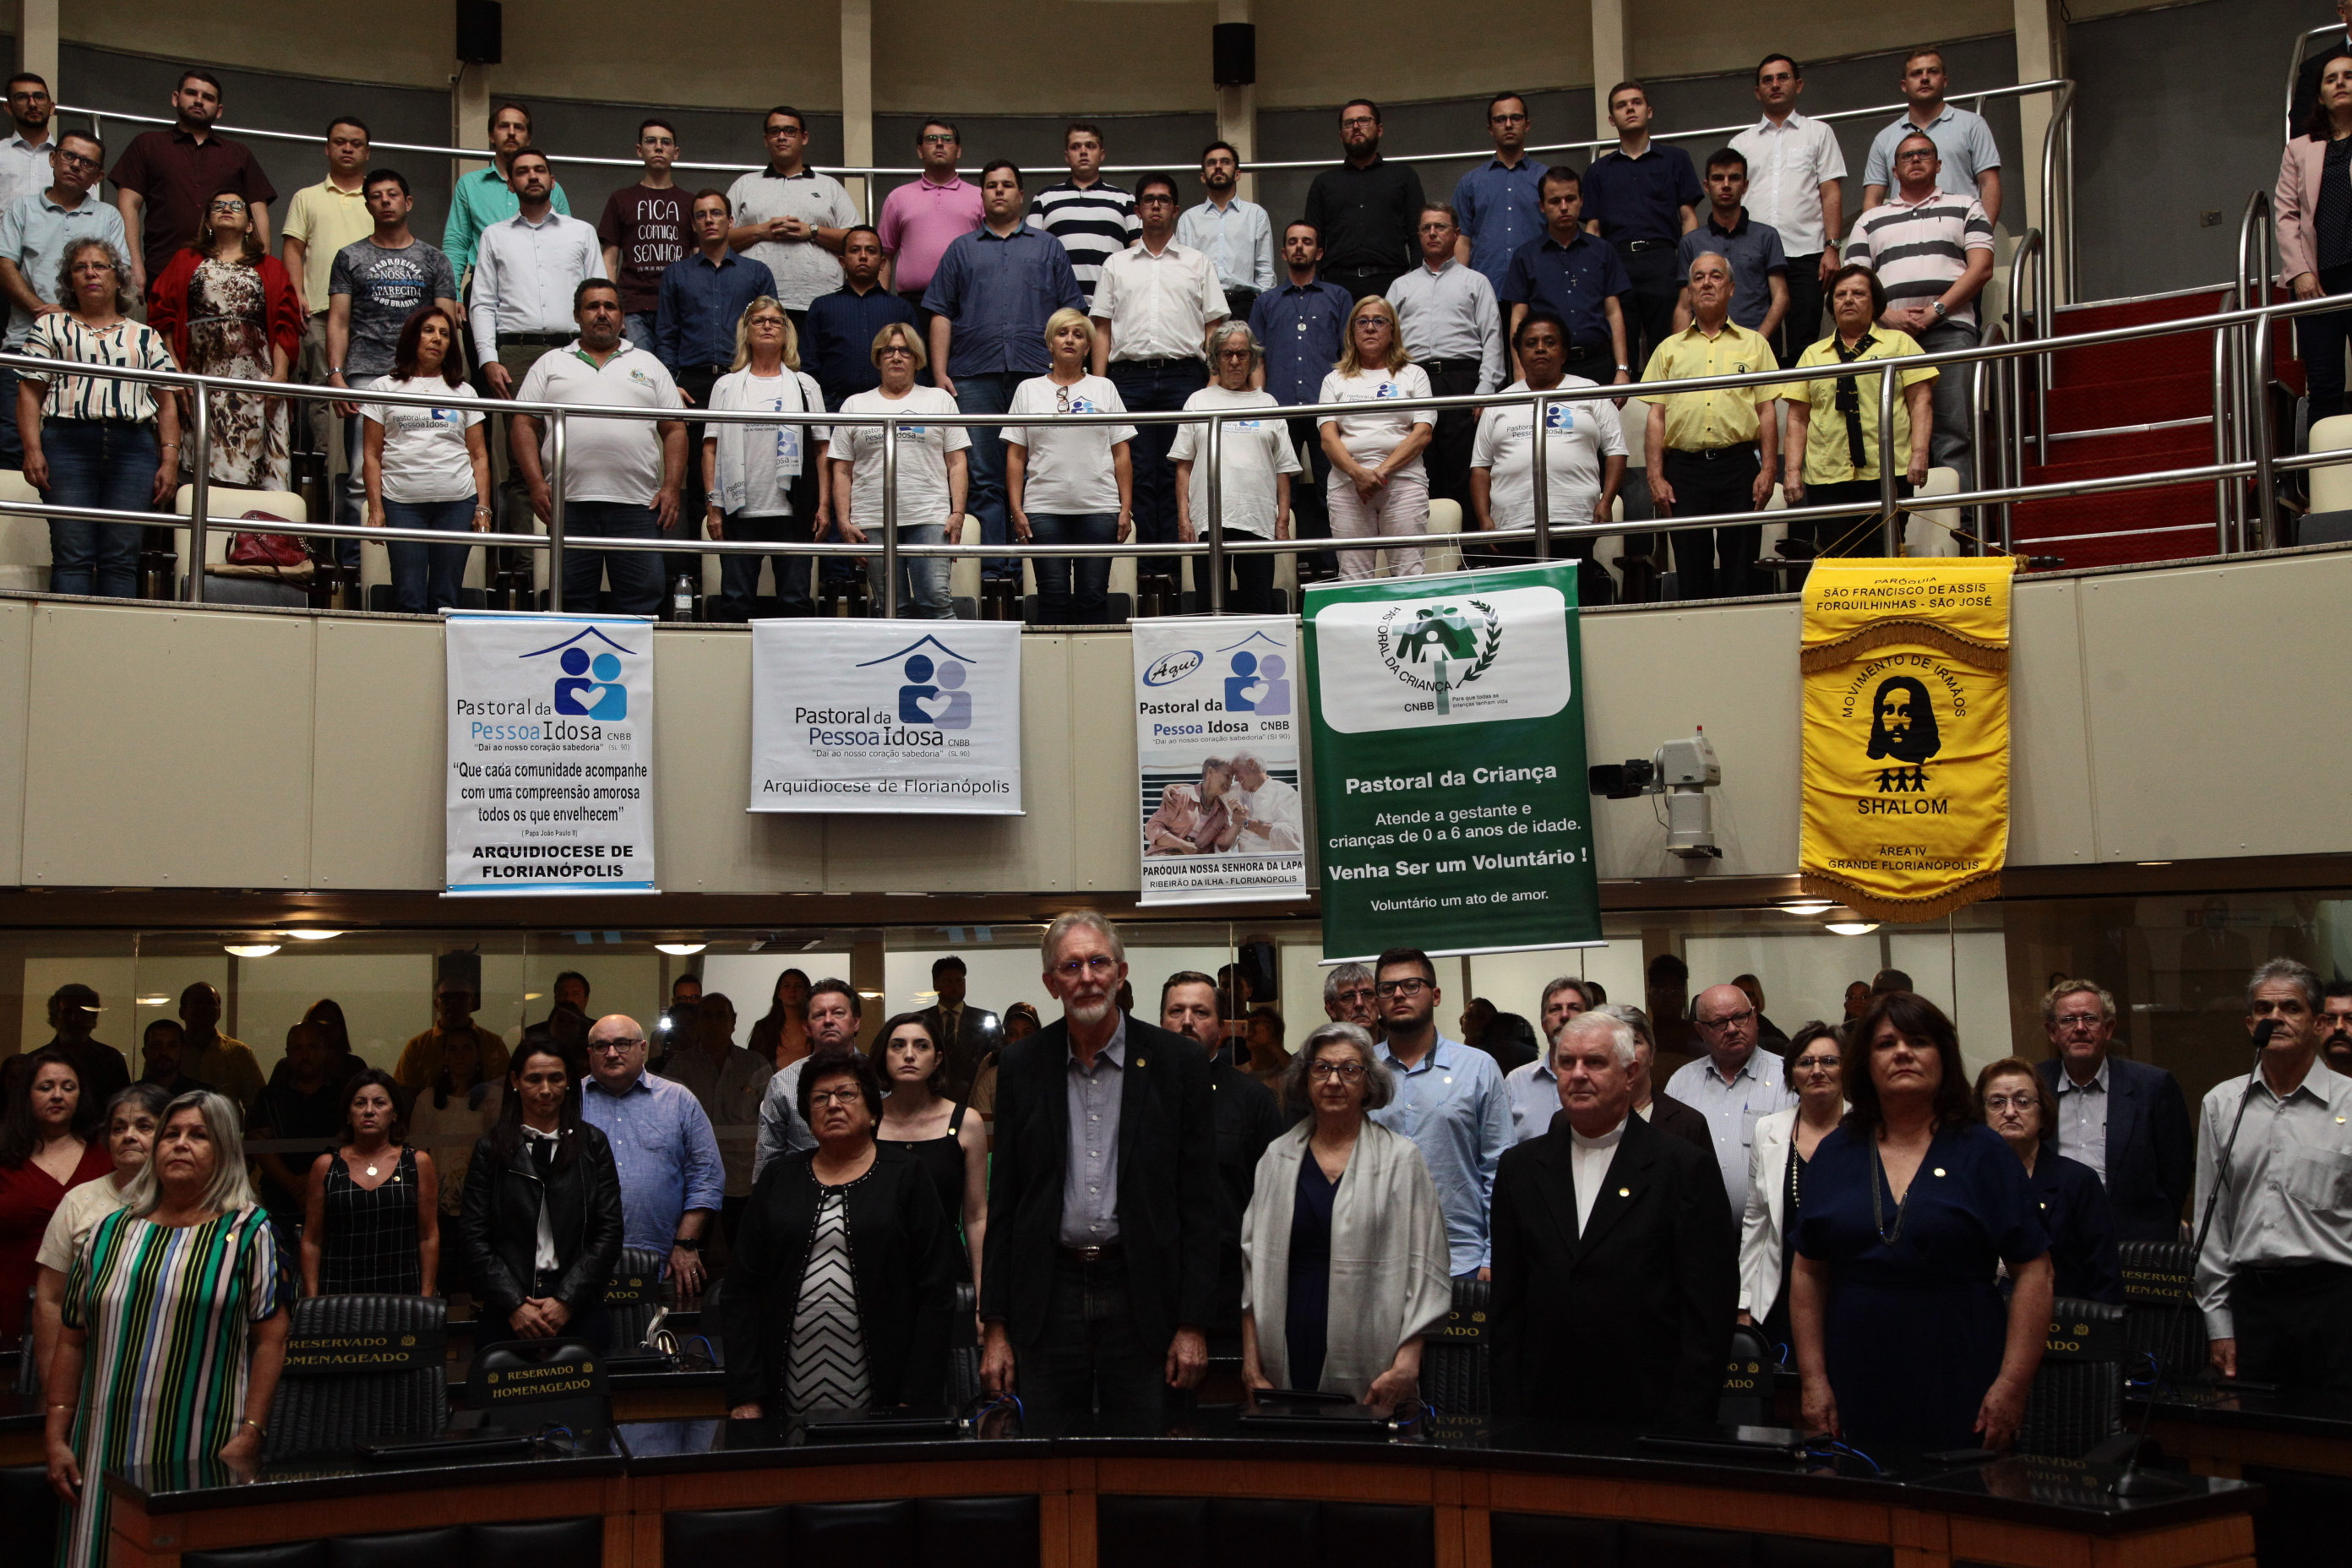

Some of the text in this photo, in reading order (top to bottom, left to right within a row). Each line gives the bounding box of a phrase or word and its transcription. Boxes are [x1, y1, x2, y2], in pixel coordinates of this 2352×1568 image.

[638, 199, 678, 221] FICA
[639, 225, 678, 241] COMIGO
[634, 243, 683, 263] SENHOR
[369, 259, 421, 275] PADROEIRA
[380, 270, 411, 280] NOSSA
[372, 286, 421, 297] APARECIDA
[391, 299, 415, 308] BRASIL
[727, 482, 744, 493] Pastor
[1824, 589, 1848, 597] SÃO
[1853, 586, 1924, 596] FRANCISCO
[1949, 584, 1986, 593] ASSIS
[1816, 600, 1916, 611] FORQUILHINHAS
[1930, 598, 1955, 607] SÃO
[1959, 596, 1992, 607] JOSÉ
[1378, 607, 1452, 694] PASTORAL DA CRIANÇA
[1152, 657, 1197, 681] Aqui
[1843, 655, 1966, 718] MOVIMENTO DE IRMÃOS
[458, 699, 551, 715] Pastoral da
[1141, 699, 1222, 714] Pastoral da
[1404, 702, 1434, 712] CNBB
[796, 707, 890, 724] Pastoral da
[1154, 721, 1289, 736] Pessoa Idosa CNBB
[531, 743, 560, 752] coração
[868, 749, 899, 759] coração
[486, 763, 511, 776] cada
[514, 763, 581, 776] comunidade
[585, 763, 647, 781] acompanhe
[1346, 765, 1556, 794] Pastoral da Criança
[461, 785, 640, 801] com uma compreensão amorosa
[764, 779, 1009, 796] Arquidiocese de Florianópolis
[1858, 799, 1947, 814] SHALOM
[479, 807, 509, 821] todos
[514, 810, 526, 821] os
[530, 810, 550, 825] que
[1375, 803, 1531, 826] Atende a gestante e
[1330, 818, 1582, 848] crianças de 0 a 6 anos de idade.
[472, 846, 633, 858] ARQUIDIOCESE DE
[1880, 846, 1926, 856] ÁREA IV
[483, 862, 623, 878] FLORIANÓPOLIS
[1143, 861, 1303, 875] PARÓQUIA NOSSA SENHORA DA LAPA
[1329, 863, 1389, 880] Venha
[1396, 861, 1429, 876] Ser
[1436, 859, 1467, 873] um
[1473, 849, 1575, 870] Voluntário
[1828, 860, 1979, 870] GRANDE FLORIANÓPOLIS
[1151, 879, 1189, 888] RIBEIRÃO
[1231, 875, 1297, 885] FLORIANÓPOLIS
[1370, 890, 1549, 912] Voluntário um ato de amor.
[289, 1337, 387, 1348] RESERVADO
[284, 1353, 410, 1365] OMENAGEADO
[508, 1365, 574, 1380] RESERVADO
[493, 1380, 591, 1398] HOMENAGEADO
